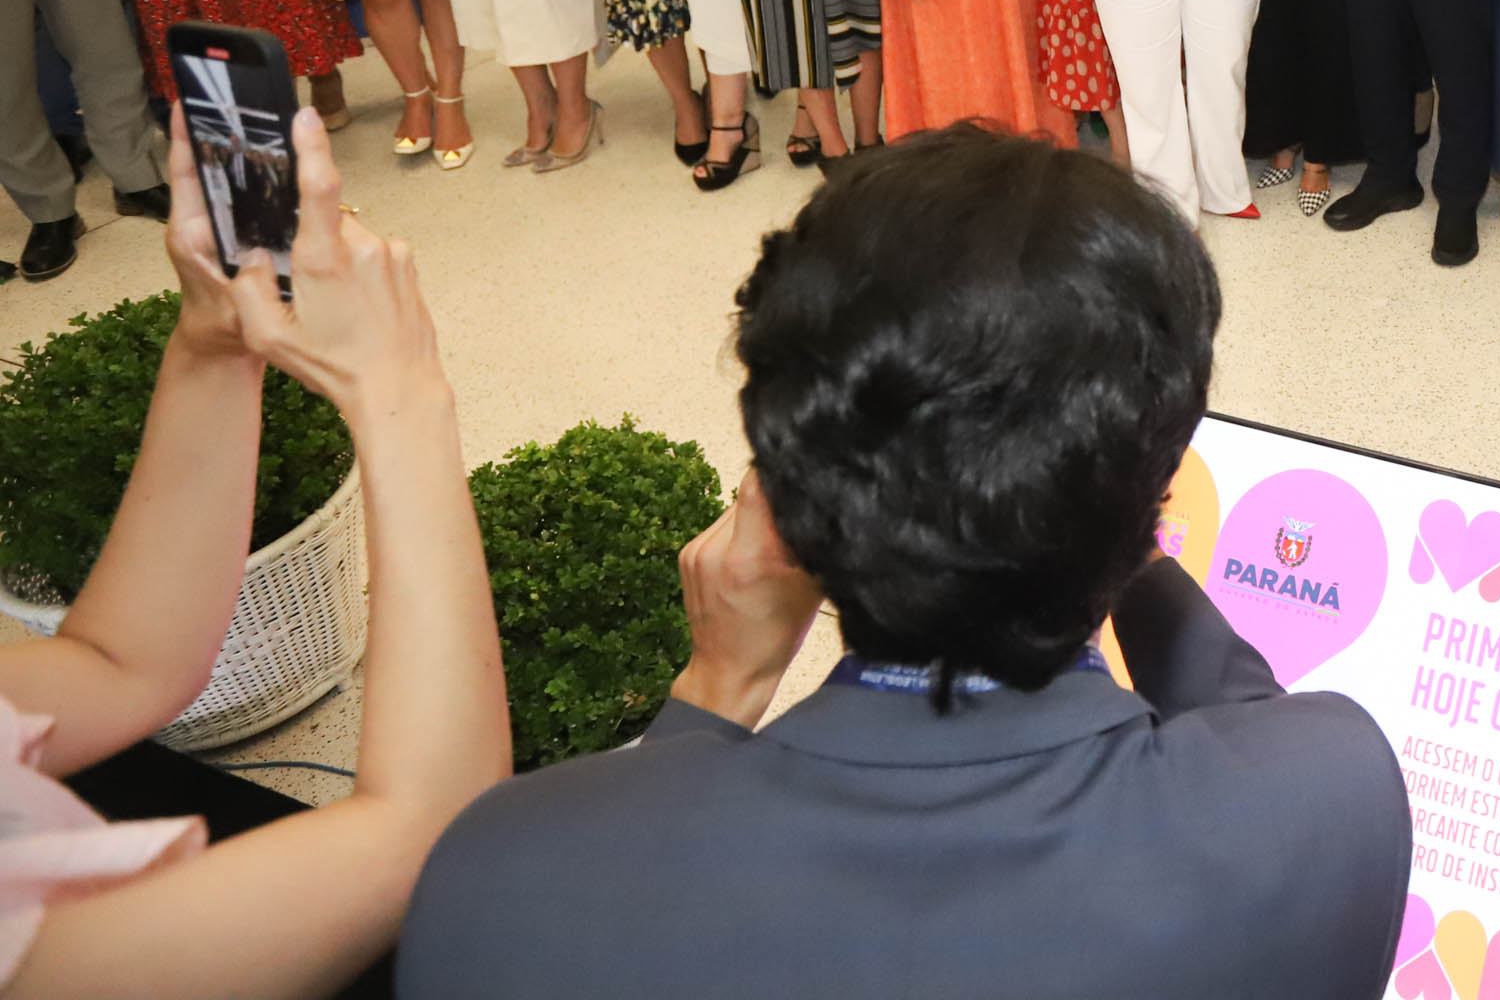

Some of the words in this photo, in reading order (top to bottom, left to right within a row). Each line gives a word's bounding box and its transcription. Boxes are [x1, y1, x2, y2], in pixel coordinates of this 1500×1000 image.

[1223, 558, 1340, 610] PARANÁ
[1410, 665, 1486, 728] HOJE
[1401, 735, 1478, 777] ACESSEM
[1482, 758, 1494, 782] O
[1442, 853, 1466, 881] DE
